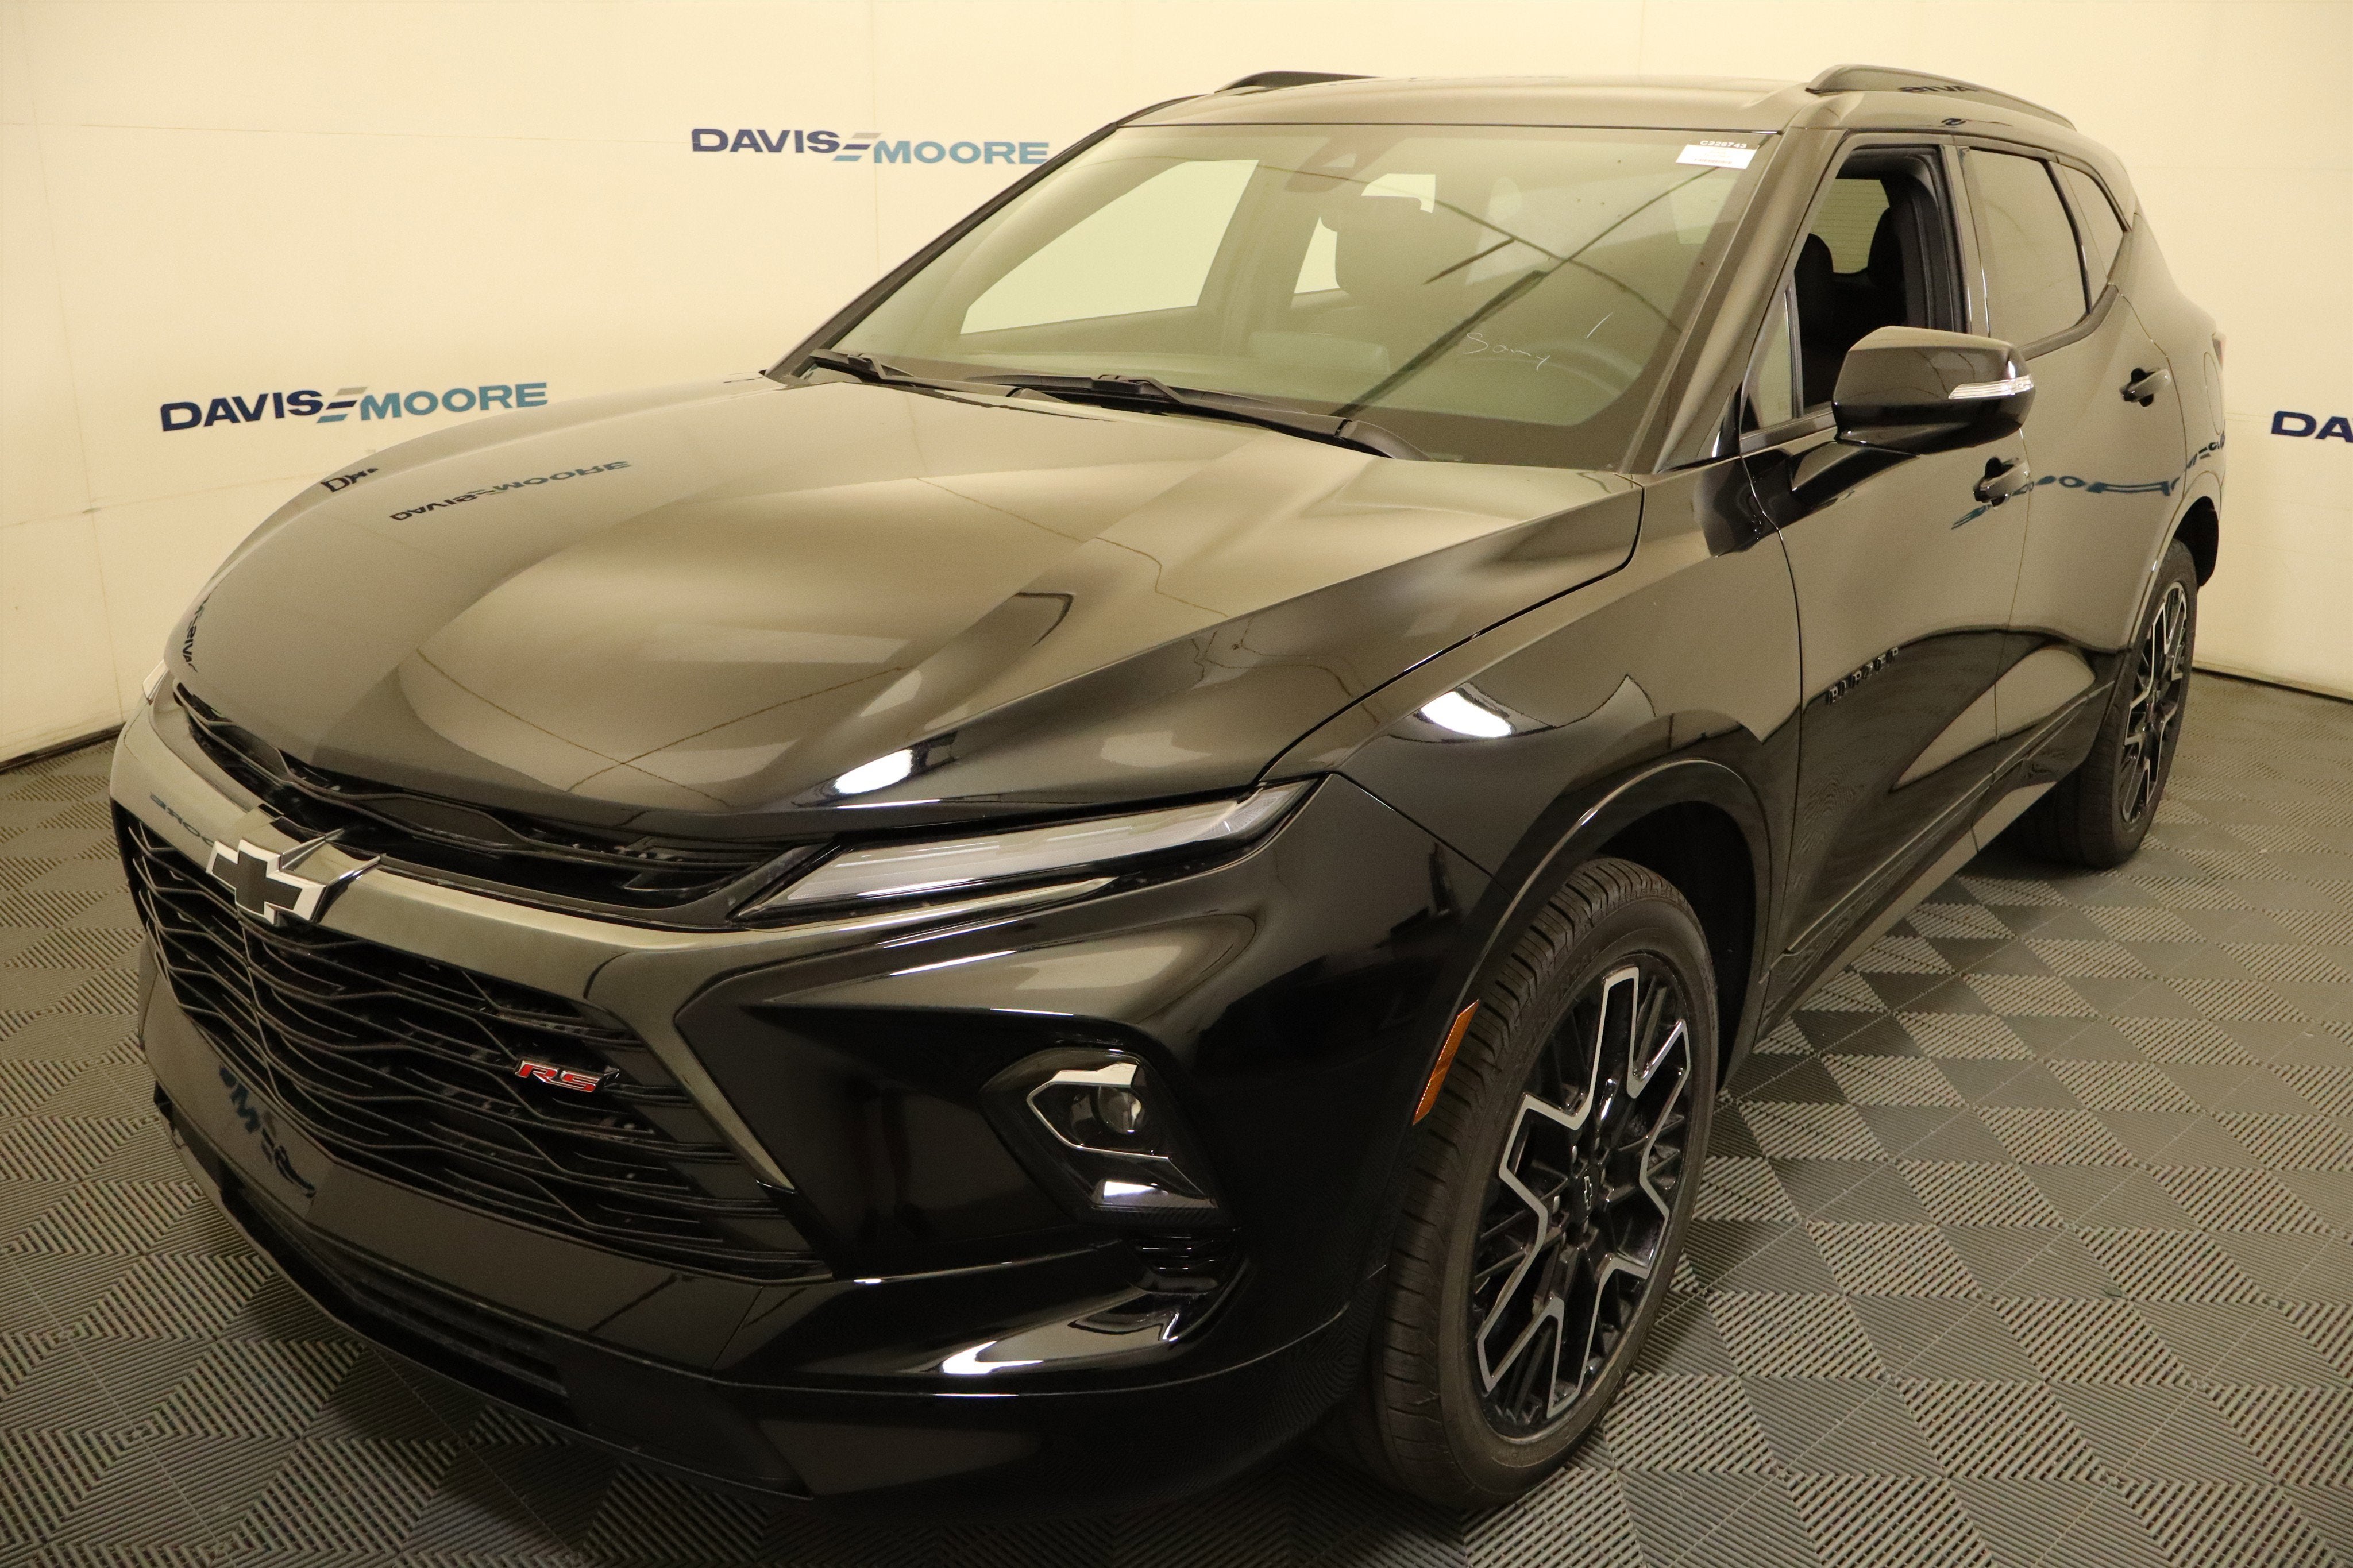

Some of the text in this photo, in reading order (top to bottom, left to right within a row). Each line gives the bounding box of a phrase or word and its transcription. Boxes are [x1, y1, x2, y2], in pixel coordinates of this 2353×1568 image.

[692, 128, 1049, 164] DAVIS MOORE
[1700, 140, 1748, 149] C226743
[160, 382, 547, 432] DAVIS MOORE
[515, 1060, 600, 1093] RS
